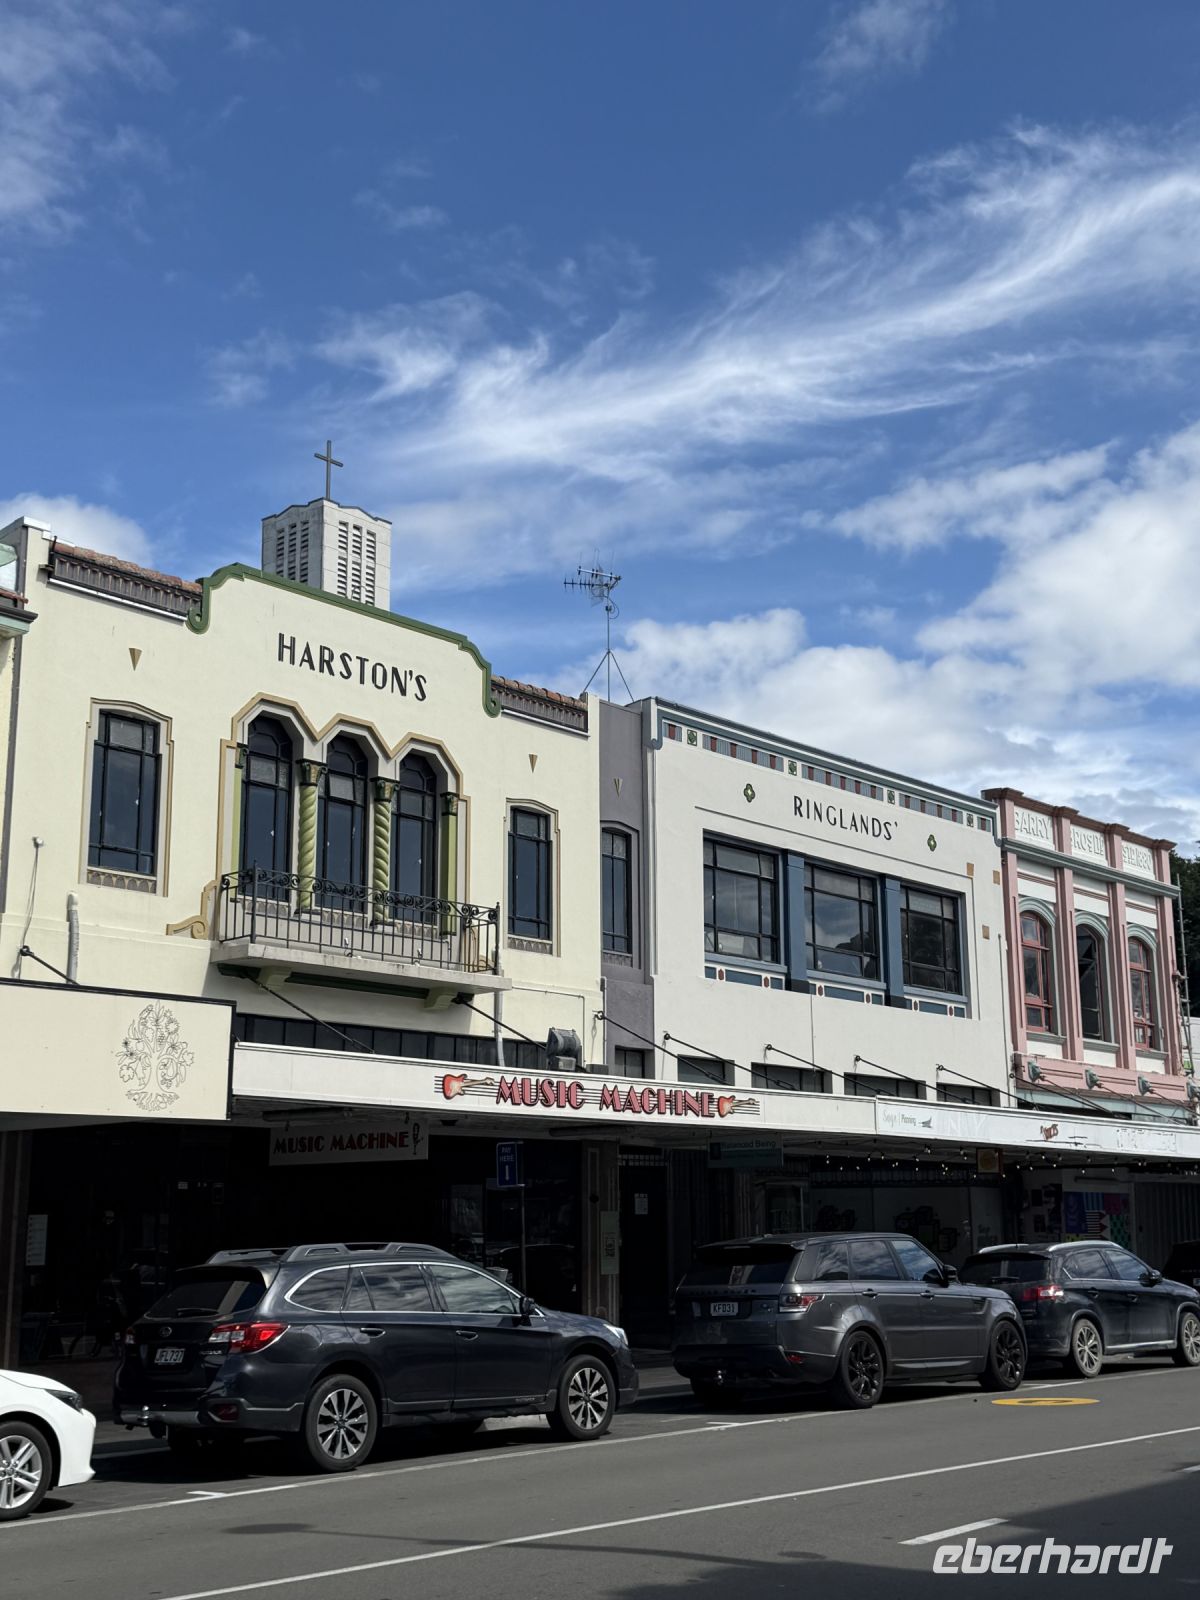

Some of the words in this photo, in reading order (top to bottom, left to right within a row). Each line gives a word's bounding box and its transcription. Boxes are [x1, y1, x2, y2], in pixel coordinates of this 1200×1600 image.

[278, 632, 427, 702] HARSTON'S
[793, 795, 898, 841] RINGLANDS'
[1014, 811, 1051, 840] BARRY
[1070, 828, 1093, 853] ROS
[495, 1075, 586, 1110] MUSIC
[599, 1083, 716, 1118] MACHINE
[273, 1135, 325, 1154] MUSIC
[330, 1131, 409, 1151] MACHINE
[156, 1350, 183, 1362] JFL737
